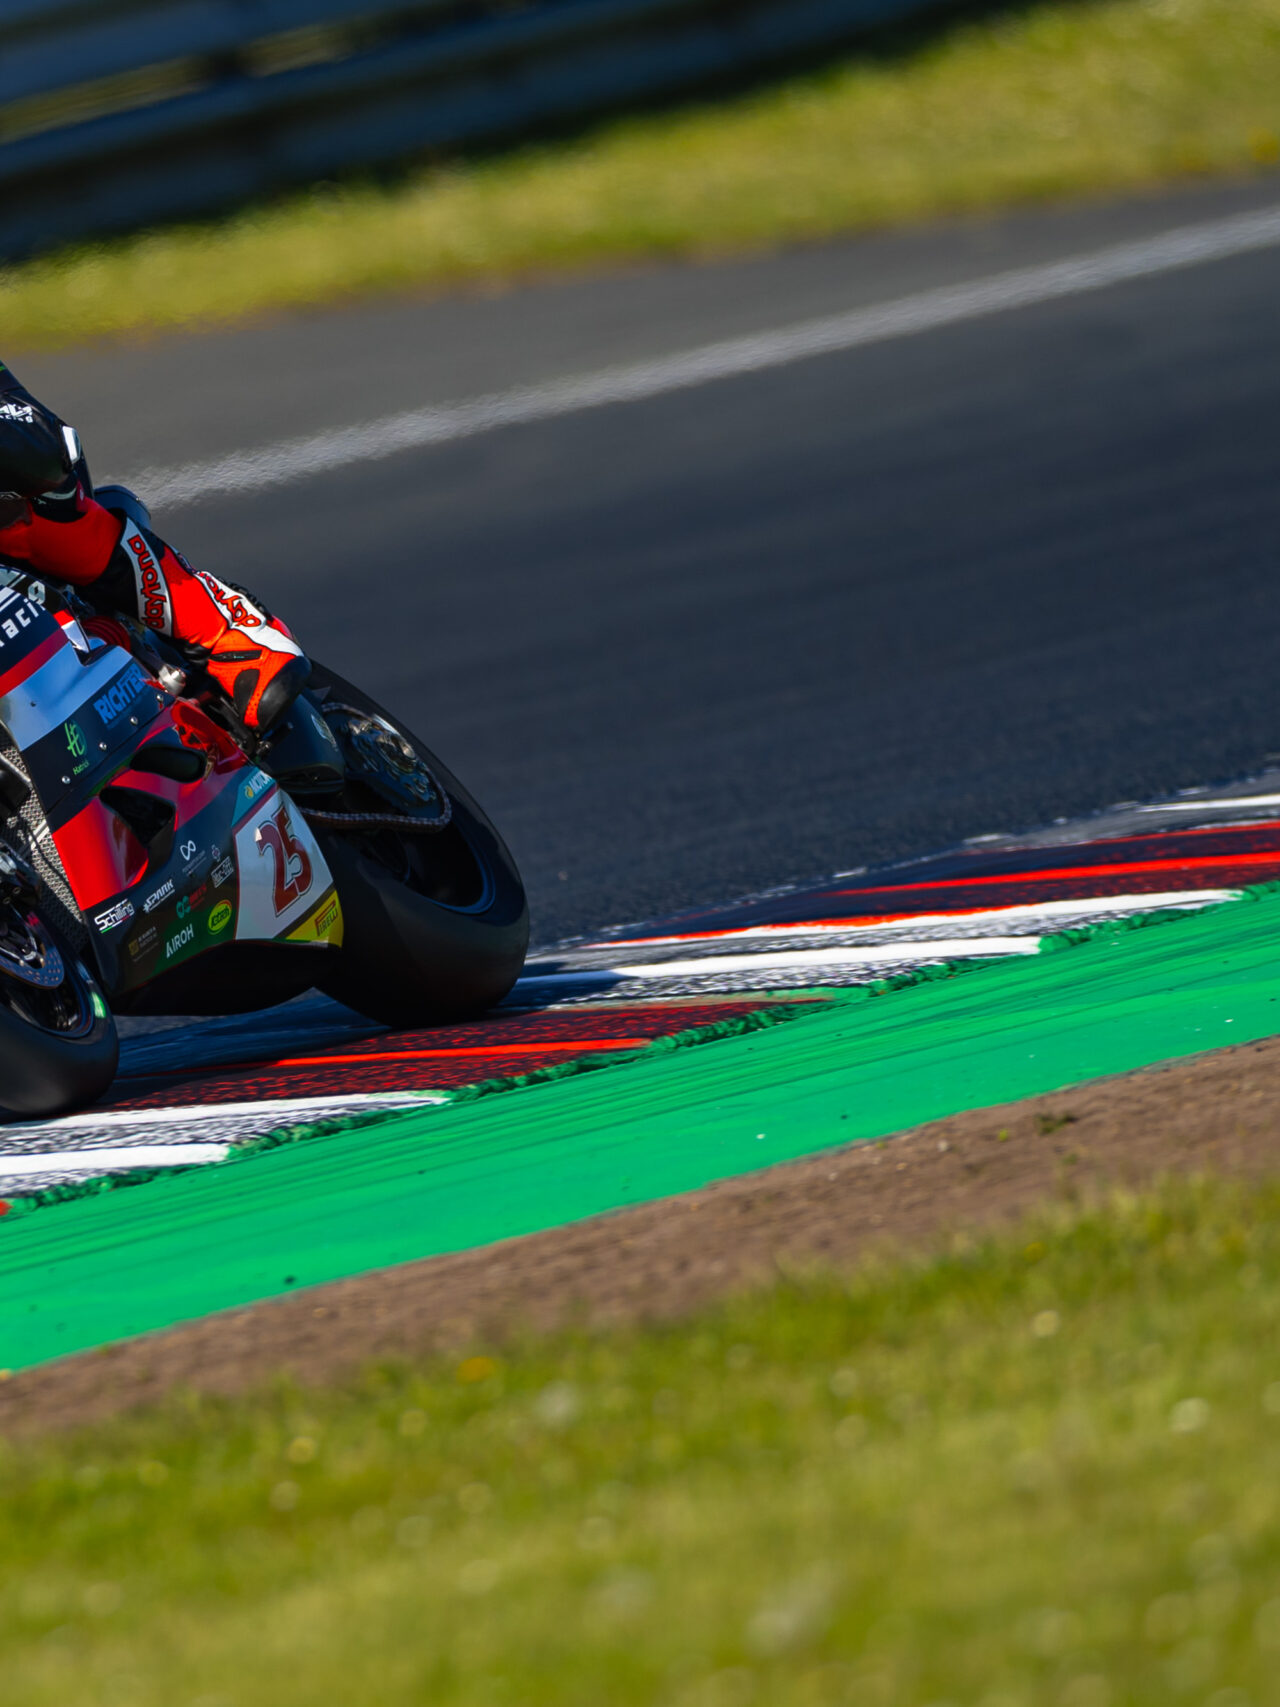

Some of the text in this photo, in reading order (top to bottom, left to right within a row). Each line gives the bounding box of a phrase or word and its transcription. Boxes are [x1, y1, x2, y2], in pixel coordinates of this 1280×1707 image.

[256, 804, 314, 918] 25
[145, 878, 175, 907] SPARK
[94, 898, 136, 931] Schilling
[314, 900, 338, 936] PIRELLI
[166, 923, 195, 958] AIROH
